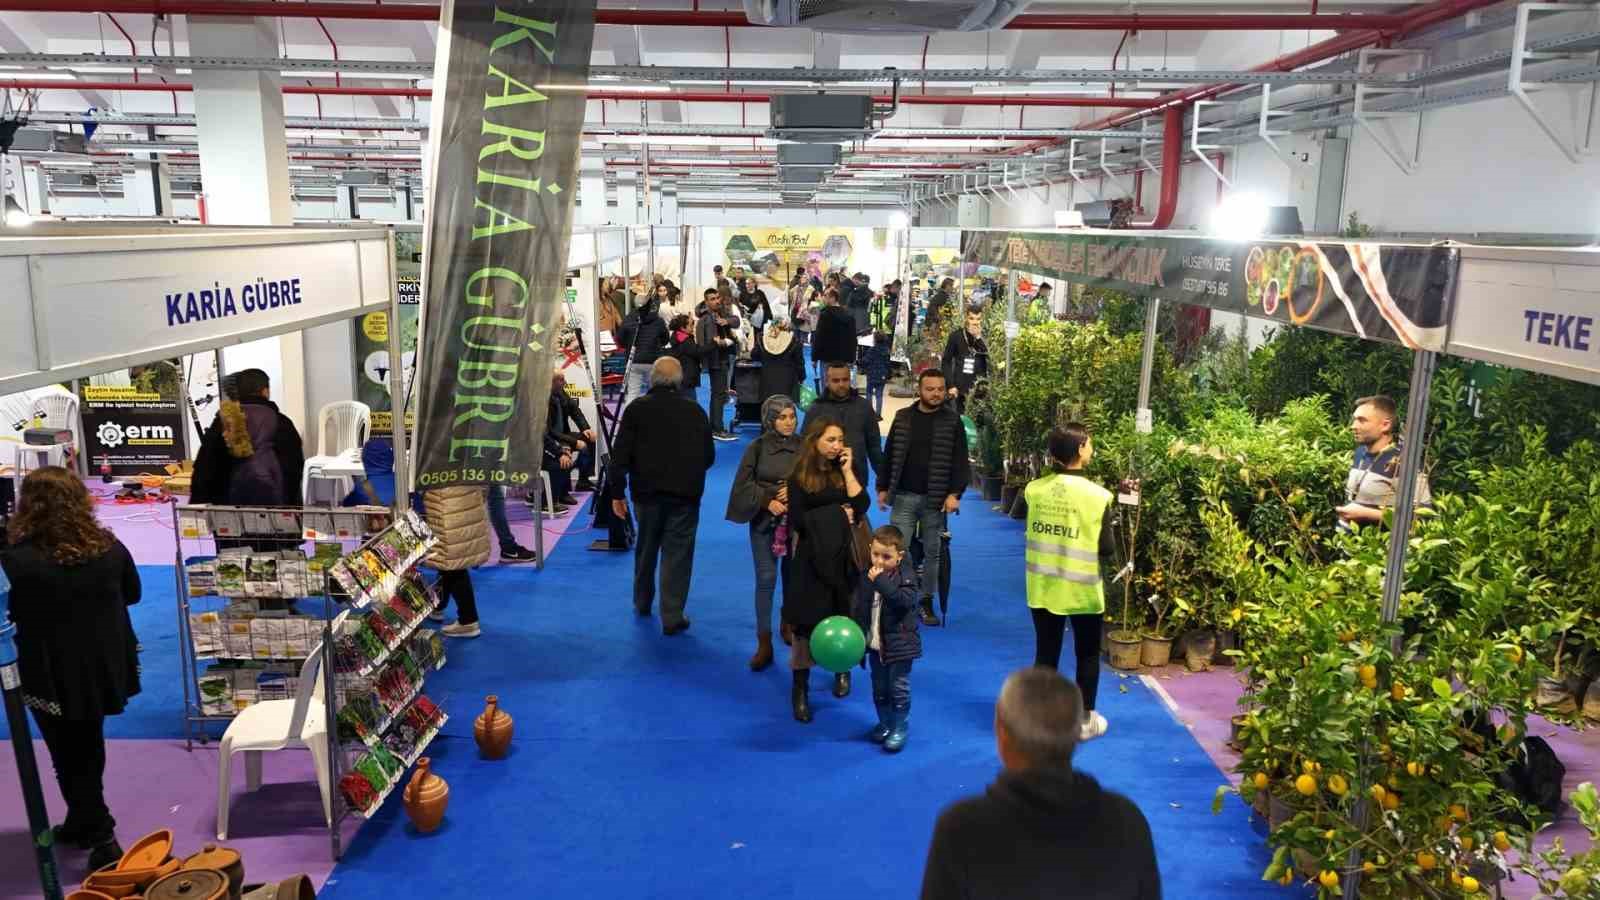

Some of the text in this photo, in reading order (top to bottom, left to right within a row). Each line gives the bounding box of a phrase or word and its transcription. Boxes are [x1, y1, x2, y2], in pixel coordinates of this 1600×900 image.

[449, 3, 562, 462] KARİA GÜBRE
[165, 277, 302, 326] KARİA GÜBRE
[1524, 309, 1593, 352] TEKE
[126, 425, 173, 439] erm
[420, 469, 529, 485] 0505 136 10 69
